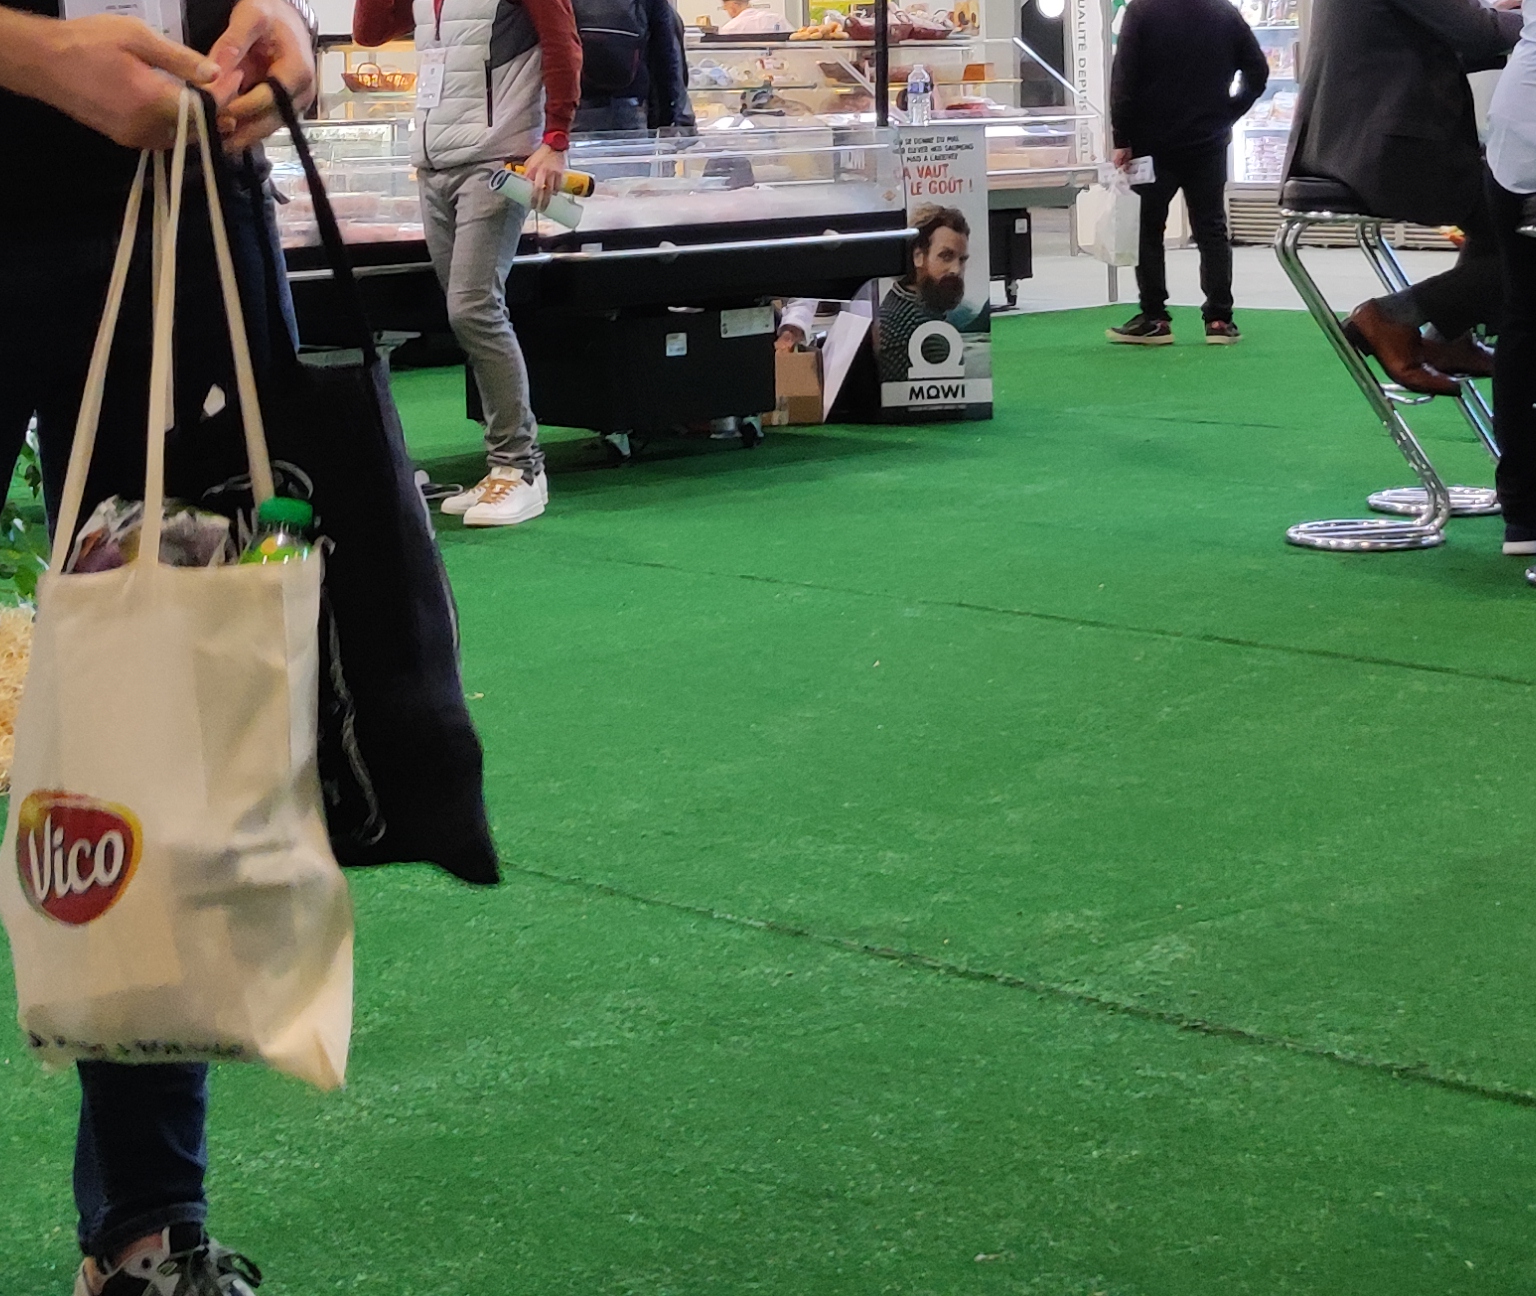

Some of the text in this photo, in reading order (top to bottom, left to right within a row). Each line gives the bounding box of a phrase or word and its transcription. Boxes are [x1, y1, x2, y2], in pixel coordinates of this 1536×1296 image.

[917, 163, 949, 180] VAUT
[911, 182, 923, 196] LE
[928, 176, 964, 195] GOÛT
[27, 812, 125, 901] Vico
